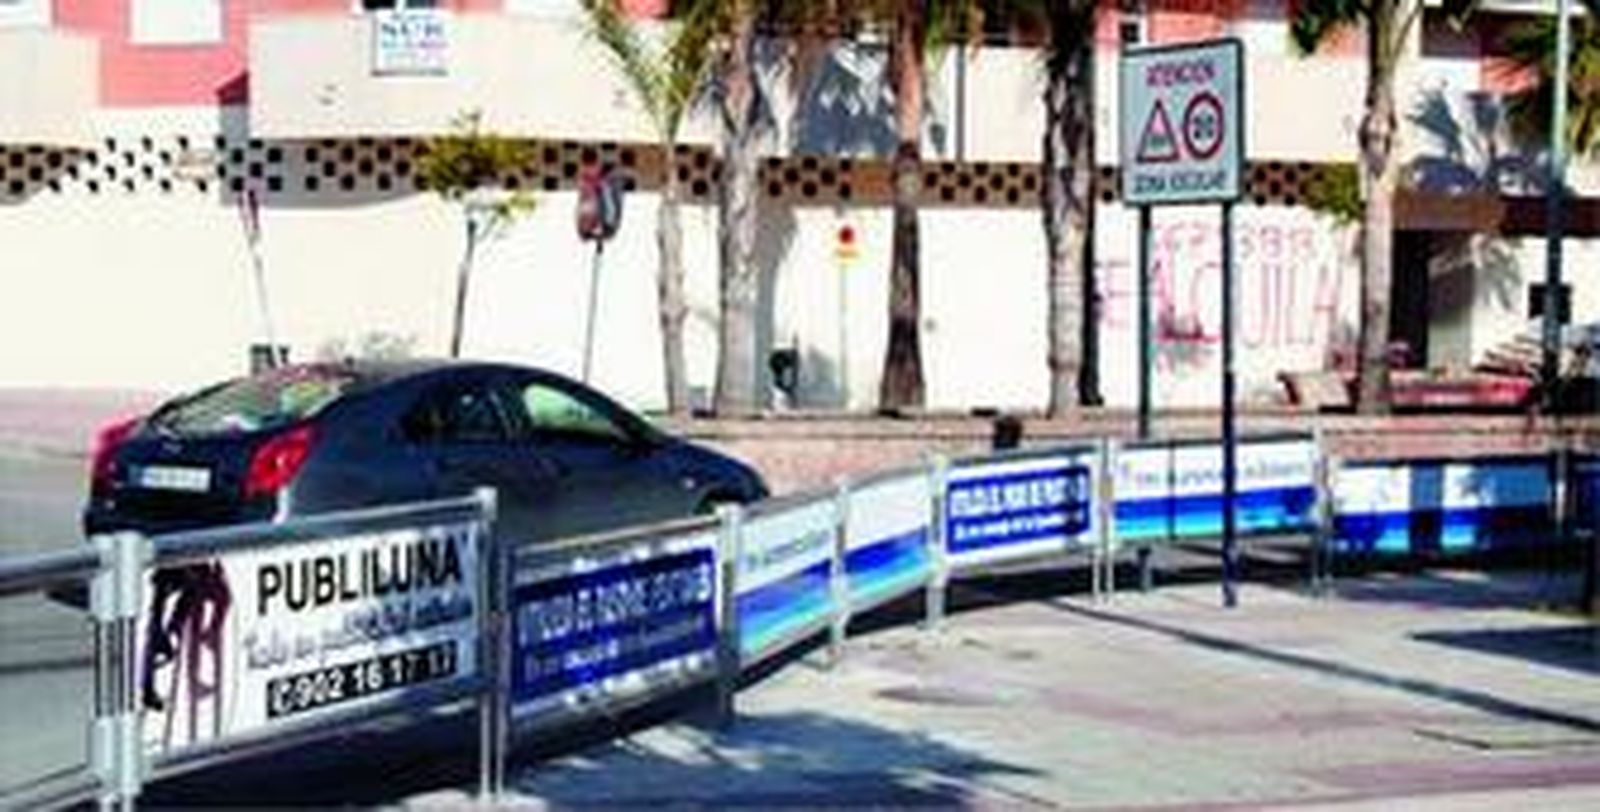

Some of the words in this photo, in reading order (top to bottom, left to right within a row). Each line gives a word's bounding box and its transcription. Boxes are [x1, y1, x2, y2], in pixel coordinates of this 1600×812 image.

[258, 534, 462, 616] PUBLILUNA
[294, 667, 346, 709] 902
[352, 660, 384, 692] 16
[391, 652, 421, 684] 17
